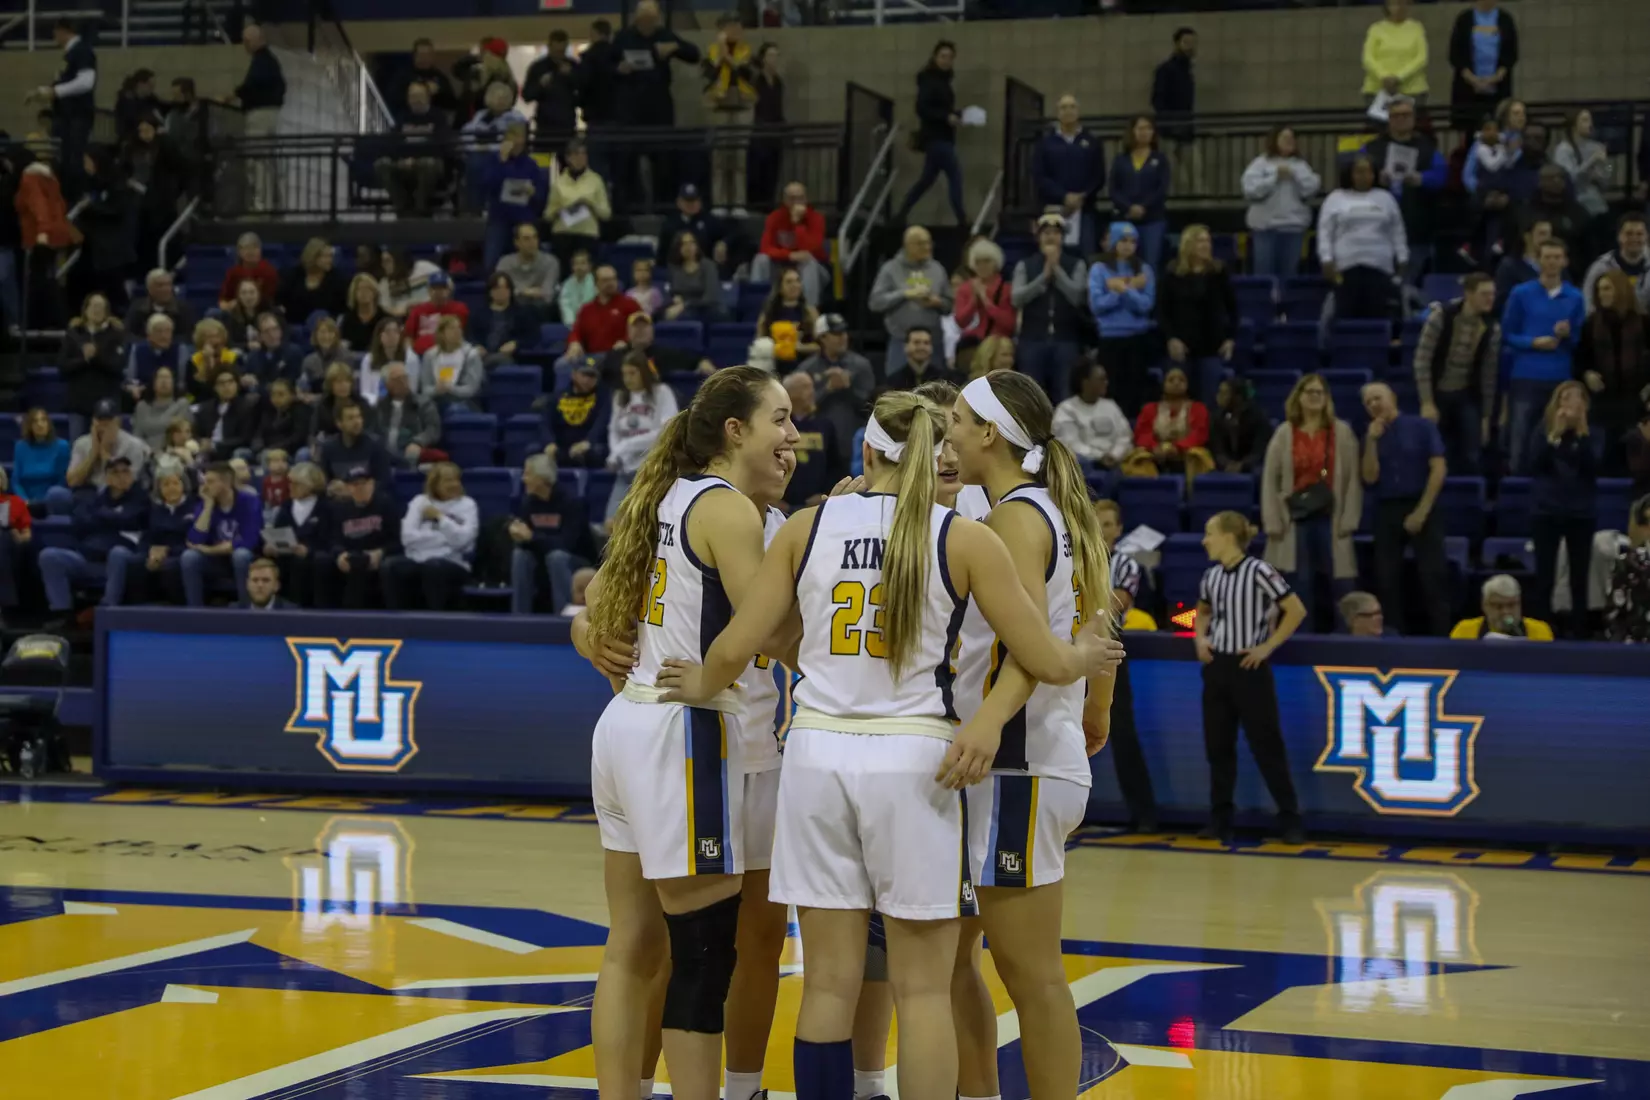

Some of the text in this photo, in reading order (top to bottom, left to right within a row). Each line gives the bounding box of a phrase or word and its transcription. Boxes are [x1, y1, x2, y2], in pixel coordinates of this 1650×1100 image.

[657, 521, 675, 547] TTA
[840, 537, 888, 570] KIN
[829, 580, 889, 660] 23
[296, 645, 410, 762] MU
[1329, 674, 1470, 808] MU
[700, 838, 719, 858] MU
[1000, 852, 1021, 872] MU
